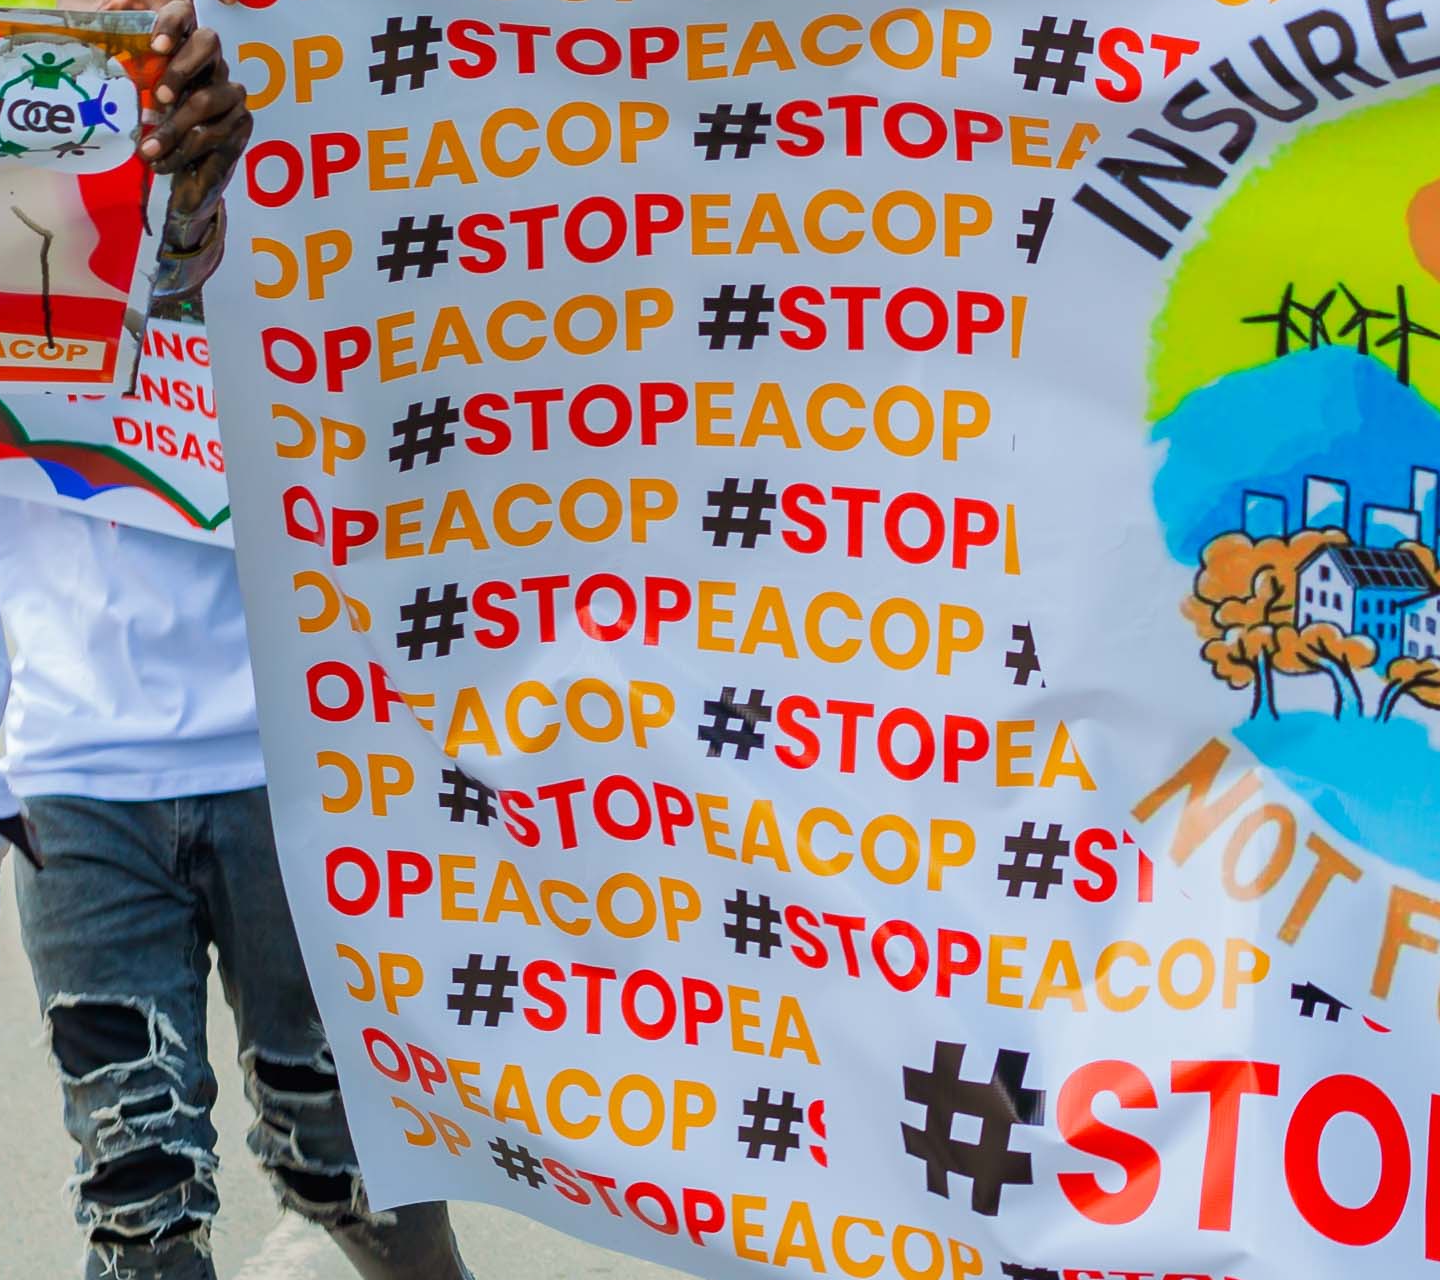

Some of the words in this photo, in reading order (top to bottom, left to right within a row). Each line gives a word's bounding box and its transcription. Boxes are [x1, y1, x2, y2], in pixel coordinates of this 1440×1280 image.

[370, 9, 991, 94] #STOPEACOP
[245, 100, 669, 207] OPEACOP
[378, 190, 992, 283] #STOPEACOP
[262, 287, 674, 393] OPEACOP
[699, 284, 1027, 358] #STOP
[120, 373, 218, 420] NSU
[390, 381, 990, 472] #STOPEACOP
[283, 479, 678, 567] OPEACOP
[703, 478, 1021, 575] #STOP
[397, 573, 984, 676] #STOPEACOP
[438, 767, 976, 891] #STOPEACOP
[1131, 734, 1361, 946] NOT
[326, 846, 701, 941] OPEACOP
[724, 889, 1271, 1013] #STOPEACOP
[362, 1027, 717, 1151] OPEACOP
